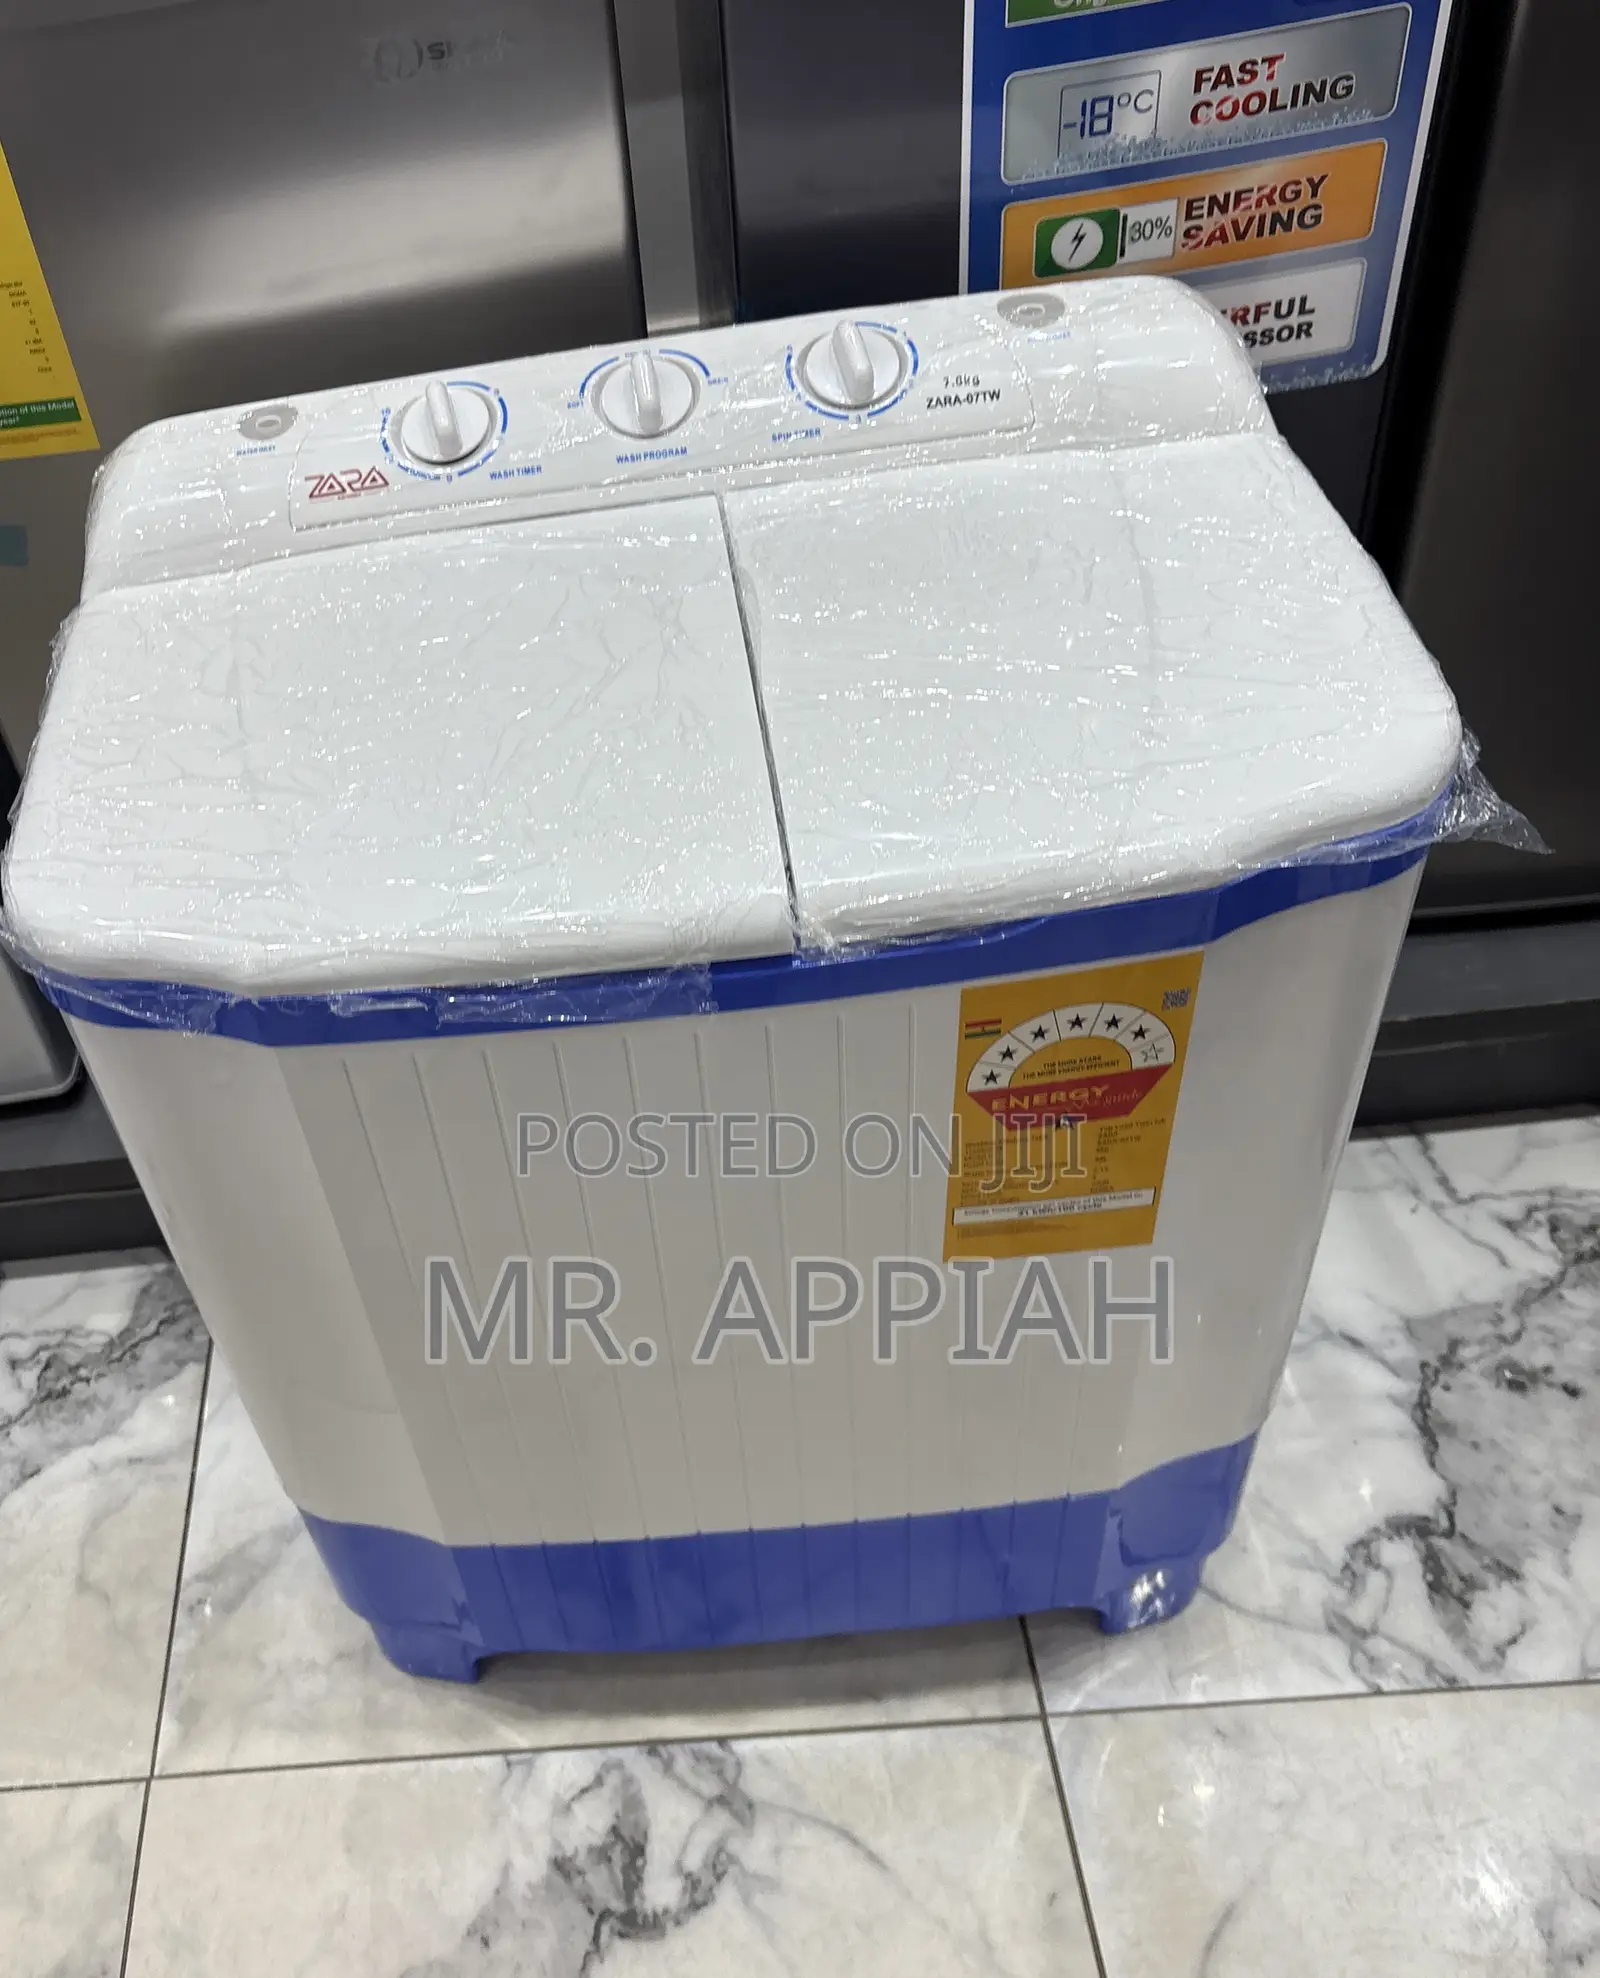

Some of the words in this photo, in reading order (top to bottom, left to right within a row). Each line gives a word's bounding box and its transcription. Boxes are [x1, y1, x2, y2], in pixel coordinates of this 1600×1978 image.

[1193, 52, 1285, 95] FAST
[1190, 75, 1355, 126] COOLING
[1184, 174, 1329, 222] ENERGY
[1130, 215, 1173, 245] 30%
[1181, 204, 1323, 250] SAVING
[926, 388, 1001, 410] ZARA-07TW
[616, 453, 642, 464] WASH
[643, 446, 687, 461] PROGRAM
[304, 465, 390, 499] ZARA
[489, 469, 515, 480] WASH
[516, 464, 542, 477] TIMER
[992, 1084, 1110, 1112] ENERGY
